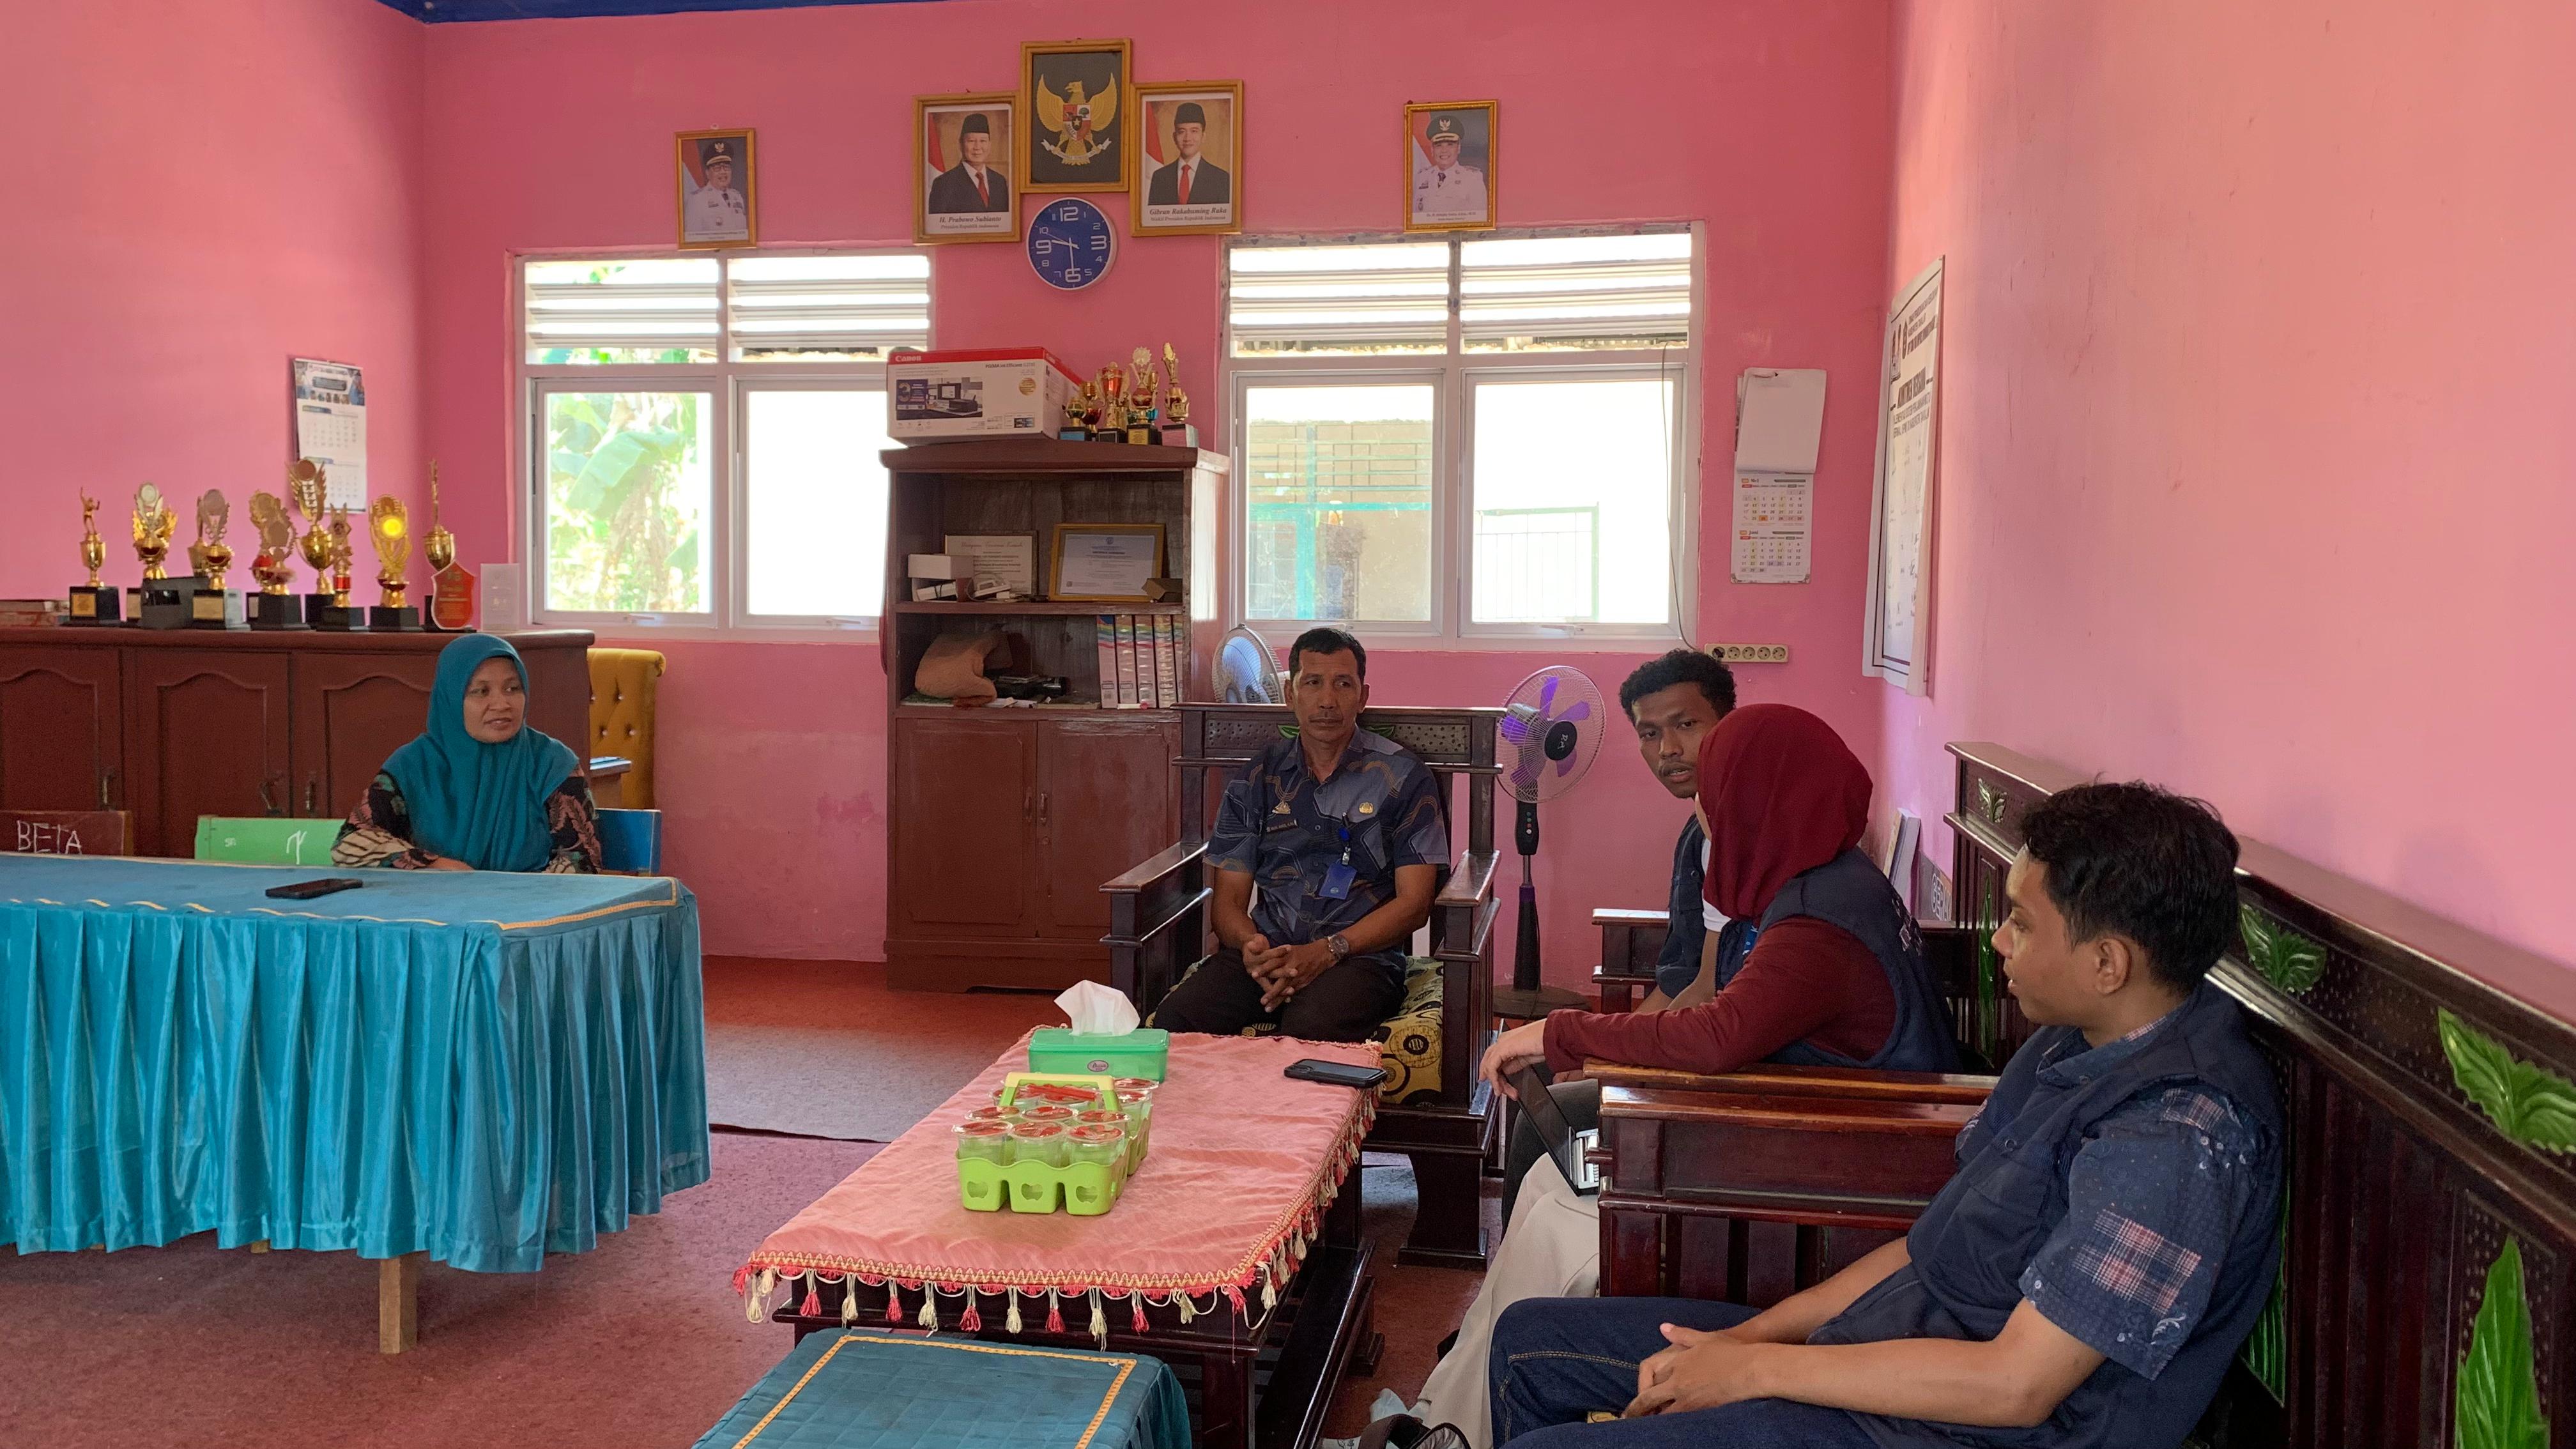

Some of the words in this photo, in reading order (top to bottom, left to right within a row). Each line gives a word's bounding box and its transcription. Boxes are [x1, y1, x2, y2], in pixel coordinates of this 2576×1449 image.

[1059, 206, 1078, 222] 12
[1036, 240, 1052, 254] 9
[1091, 235, 1107, 250] 3
[1065, 268, 1081, 282] 6
[17, 820, 82, 855] BETA
